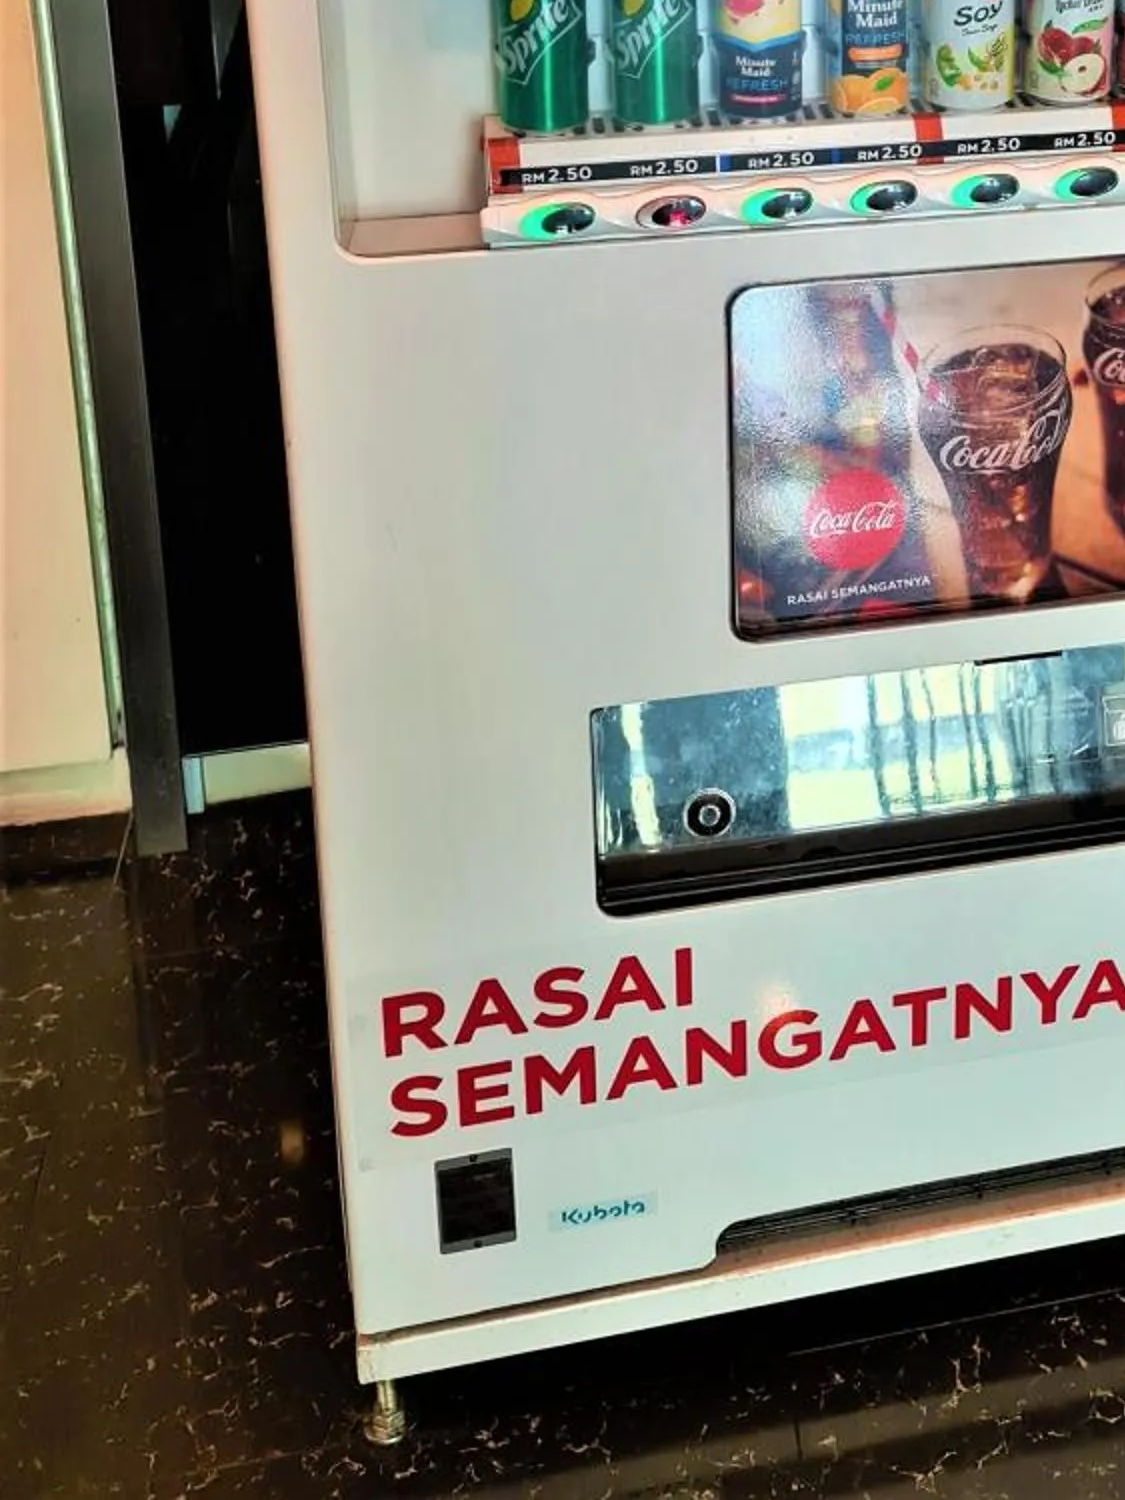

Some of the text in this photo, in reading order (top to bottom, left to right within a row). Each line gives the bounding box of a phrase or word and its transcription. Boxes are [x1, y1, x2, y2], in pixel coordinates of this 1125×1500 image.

[856, 11, 898, 29] Maid
[954, 0, 1003, 27] Soy
[981, 137, 1021, 153] 2.50
[1078, 131, 1116, 147] 2.50
[772, 152, 815, 168] 2.50
[880, 144, 923, 160] 2.50
[548, 166, 592, 183] 2.50
[655, 159, 698, 176] 2.50
[787, 574, 931, 606] RASAI SEMANGATNYA
[381, 947, 694, 1059] RASAI
[561, 1199, 646, 1225] Kubota
